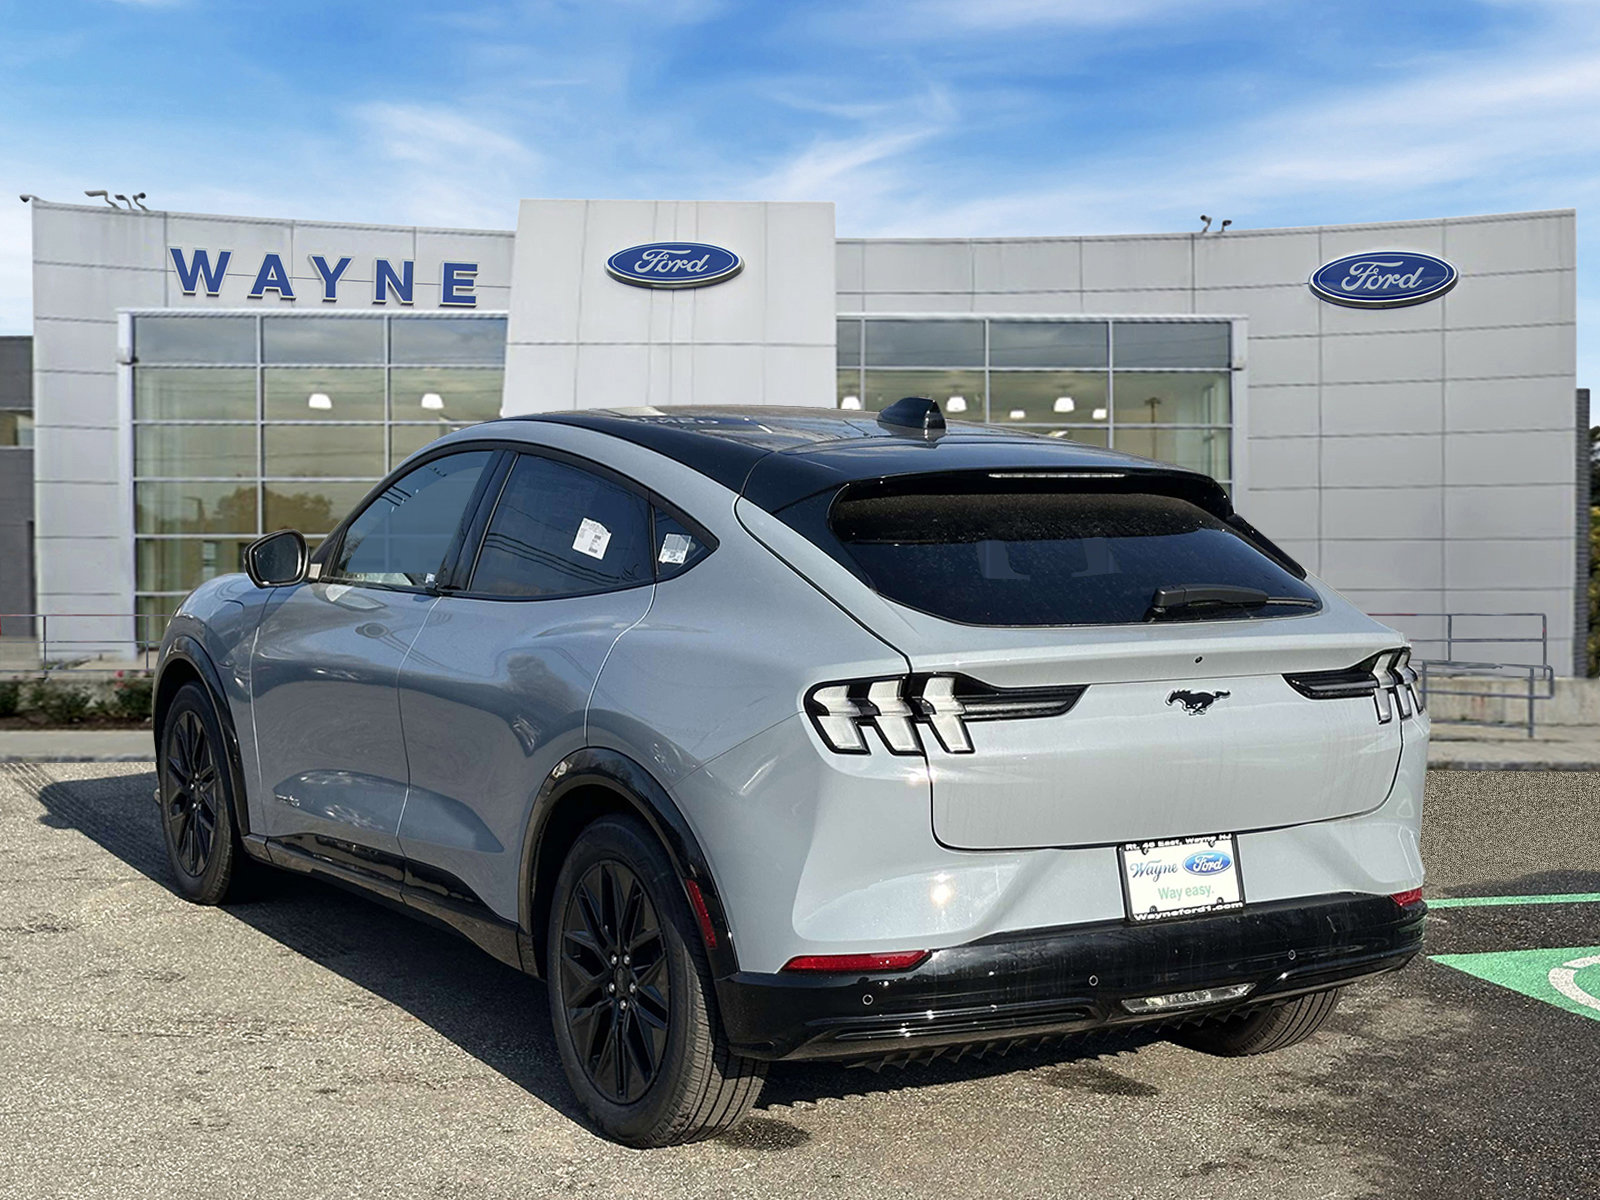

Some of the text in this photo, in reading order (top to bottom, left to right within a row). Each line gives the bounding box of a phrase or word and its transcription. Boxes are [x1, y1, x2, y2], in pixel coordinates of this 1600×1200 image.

[634, 249, 710, 273] Ford
[169, 246, 479, 307] WAYNE
[1341, 261, 1424, 291] Ford
[1130, 854, 1224, 882] Wayne Ford
[1157, 884, 1215, 902] Way easy.
